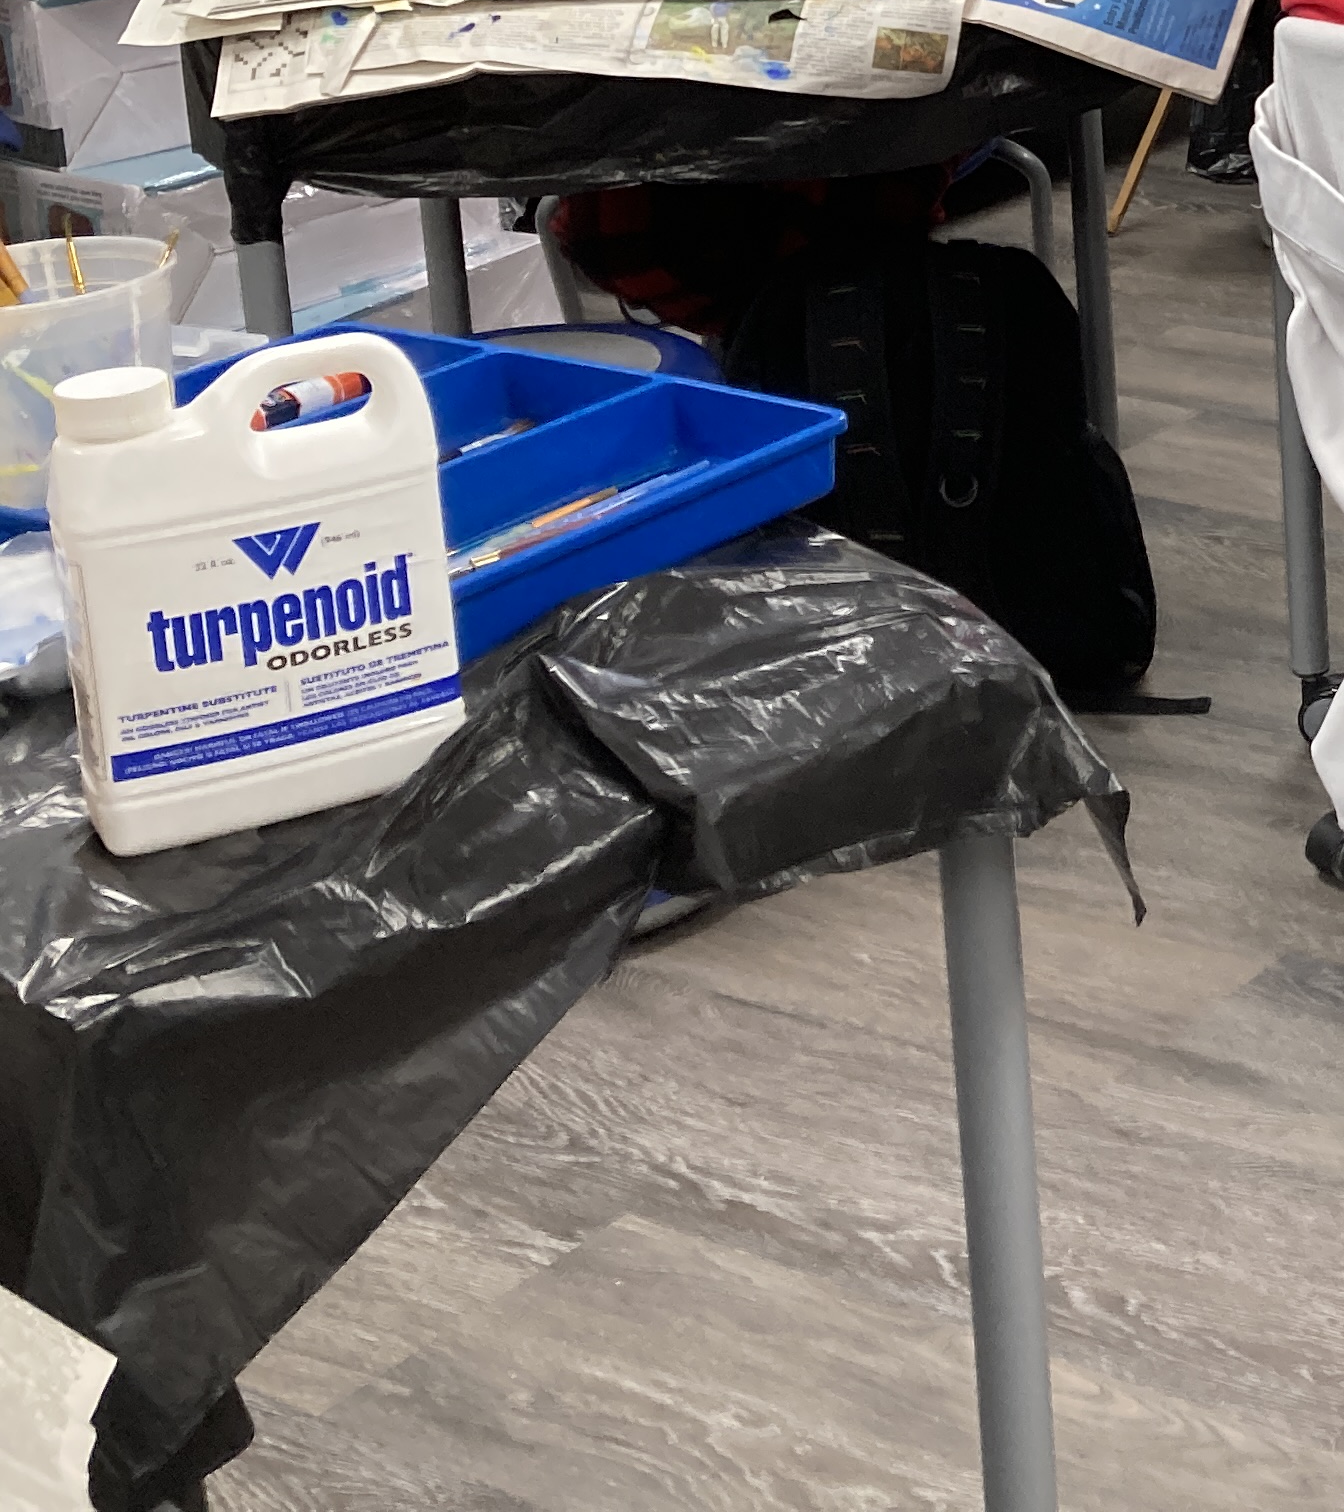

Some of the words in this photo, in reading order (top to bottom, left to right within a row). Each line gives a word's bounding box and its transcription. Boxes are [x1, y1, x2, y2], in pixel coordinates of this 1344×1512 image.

[147, 554, 413, 672] turpenoid
[266, 623, 414, 671] ODORLESS
[118, 702, 199, 724] TURPENTINE
[202, 685, 277, 708] SUBSTITUTE
